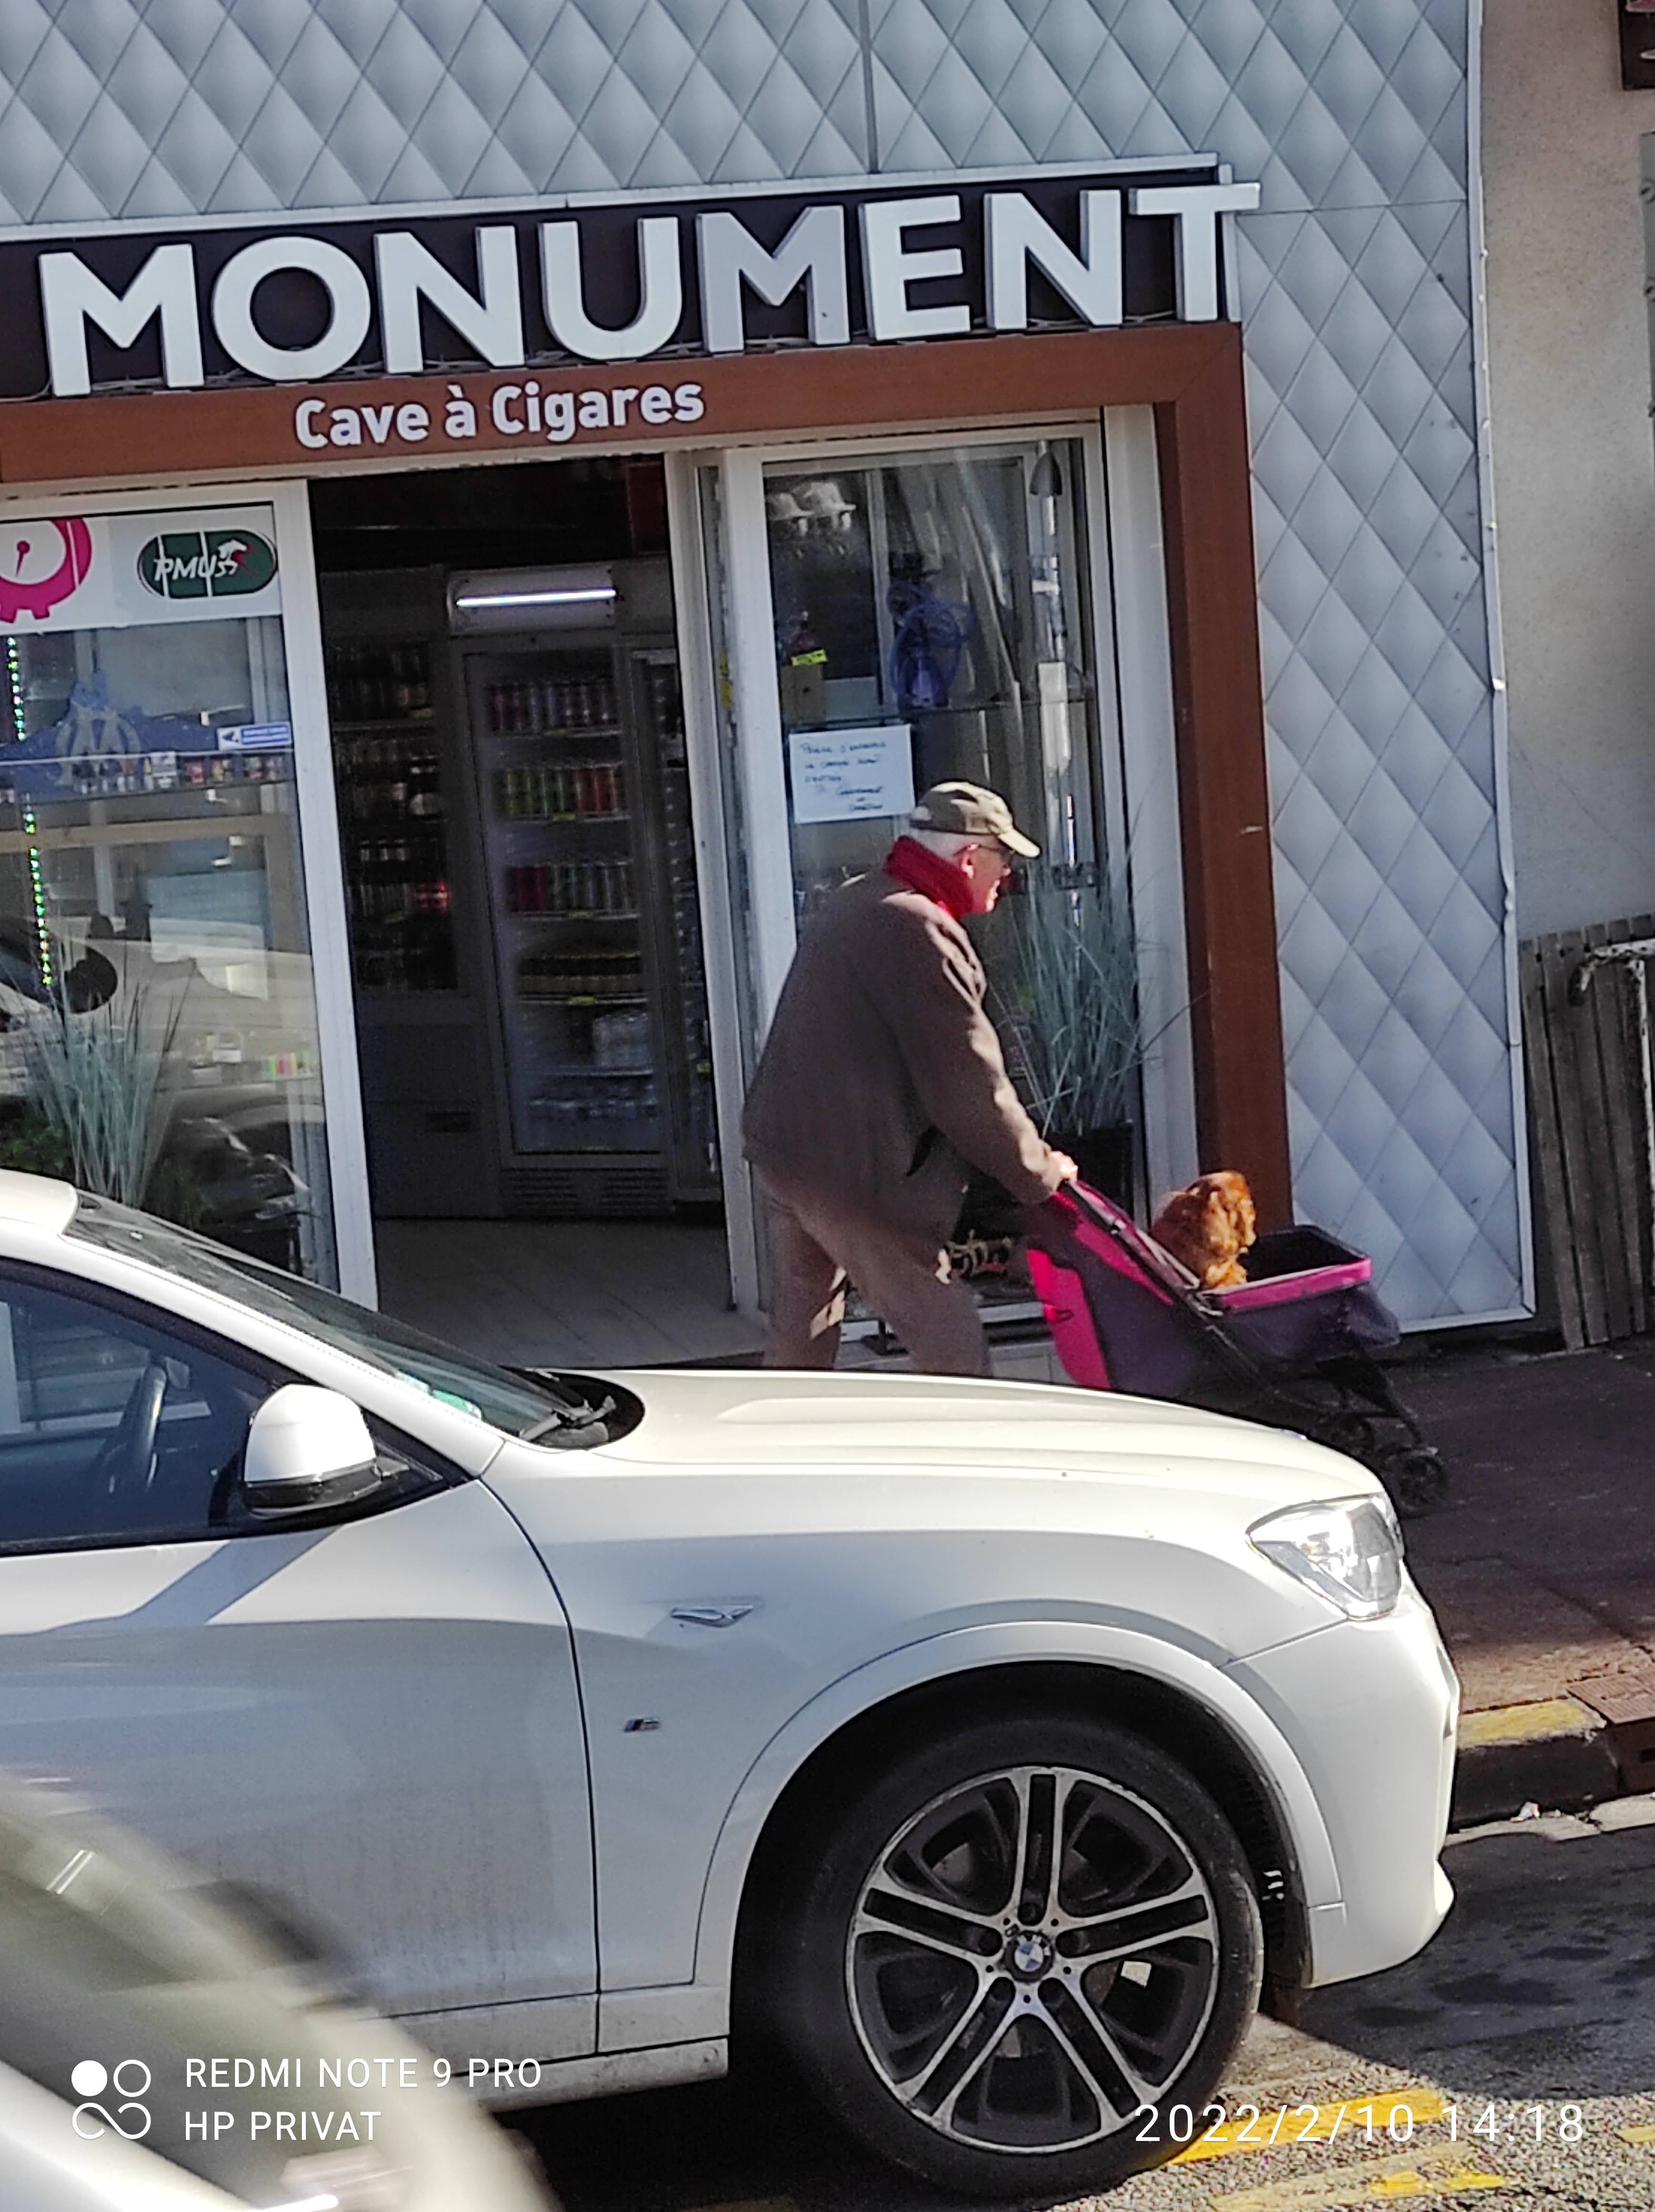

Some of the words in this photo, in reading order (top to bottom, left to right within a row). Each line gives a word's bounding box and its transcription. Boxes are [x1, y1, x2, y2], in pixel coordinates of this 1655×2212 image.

[39, 183, 1260, 397] MONUMENT
[296, 399, 429, 448] Cave
[445, 385, 476, 437] à
[492, 381, 704, 441] Cigares
[153, 554, 217, 581] PMU
